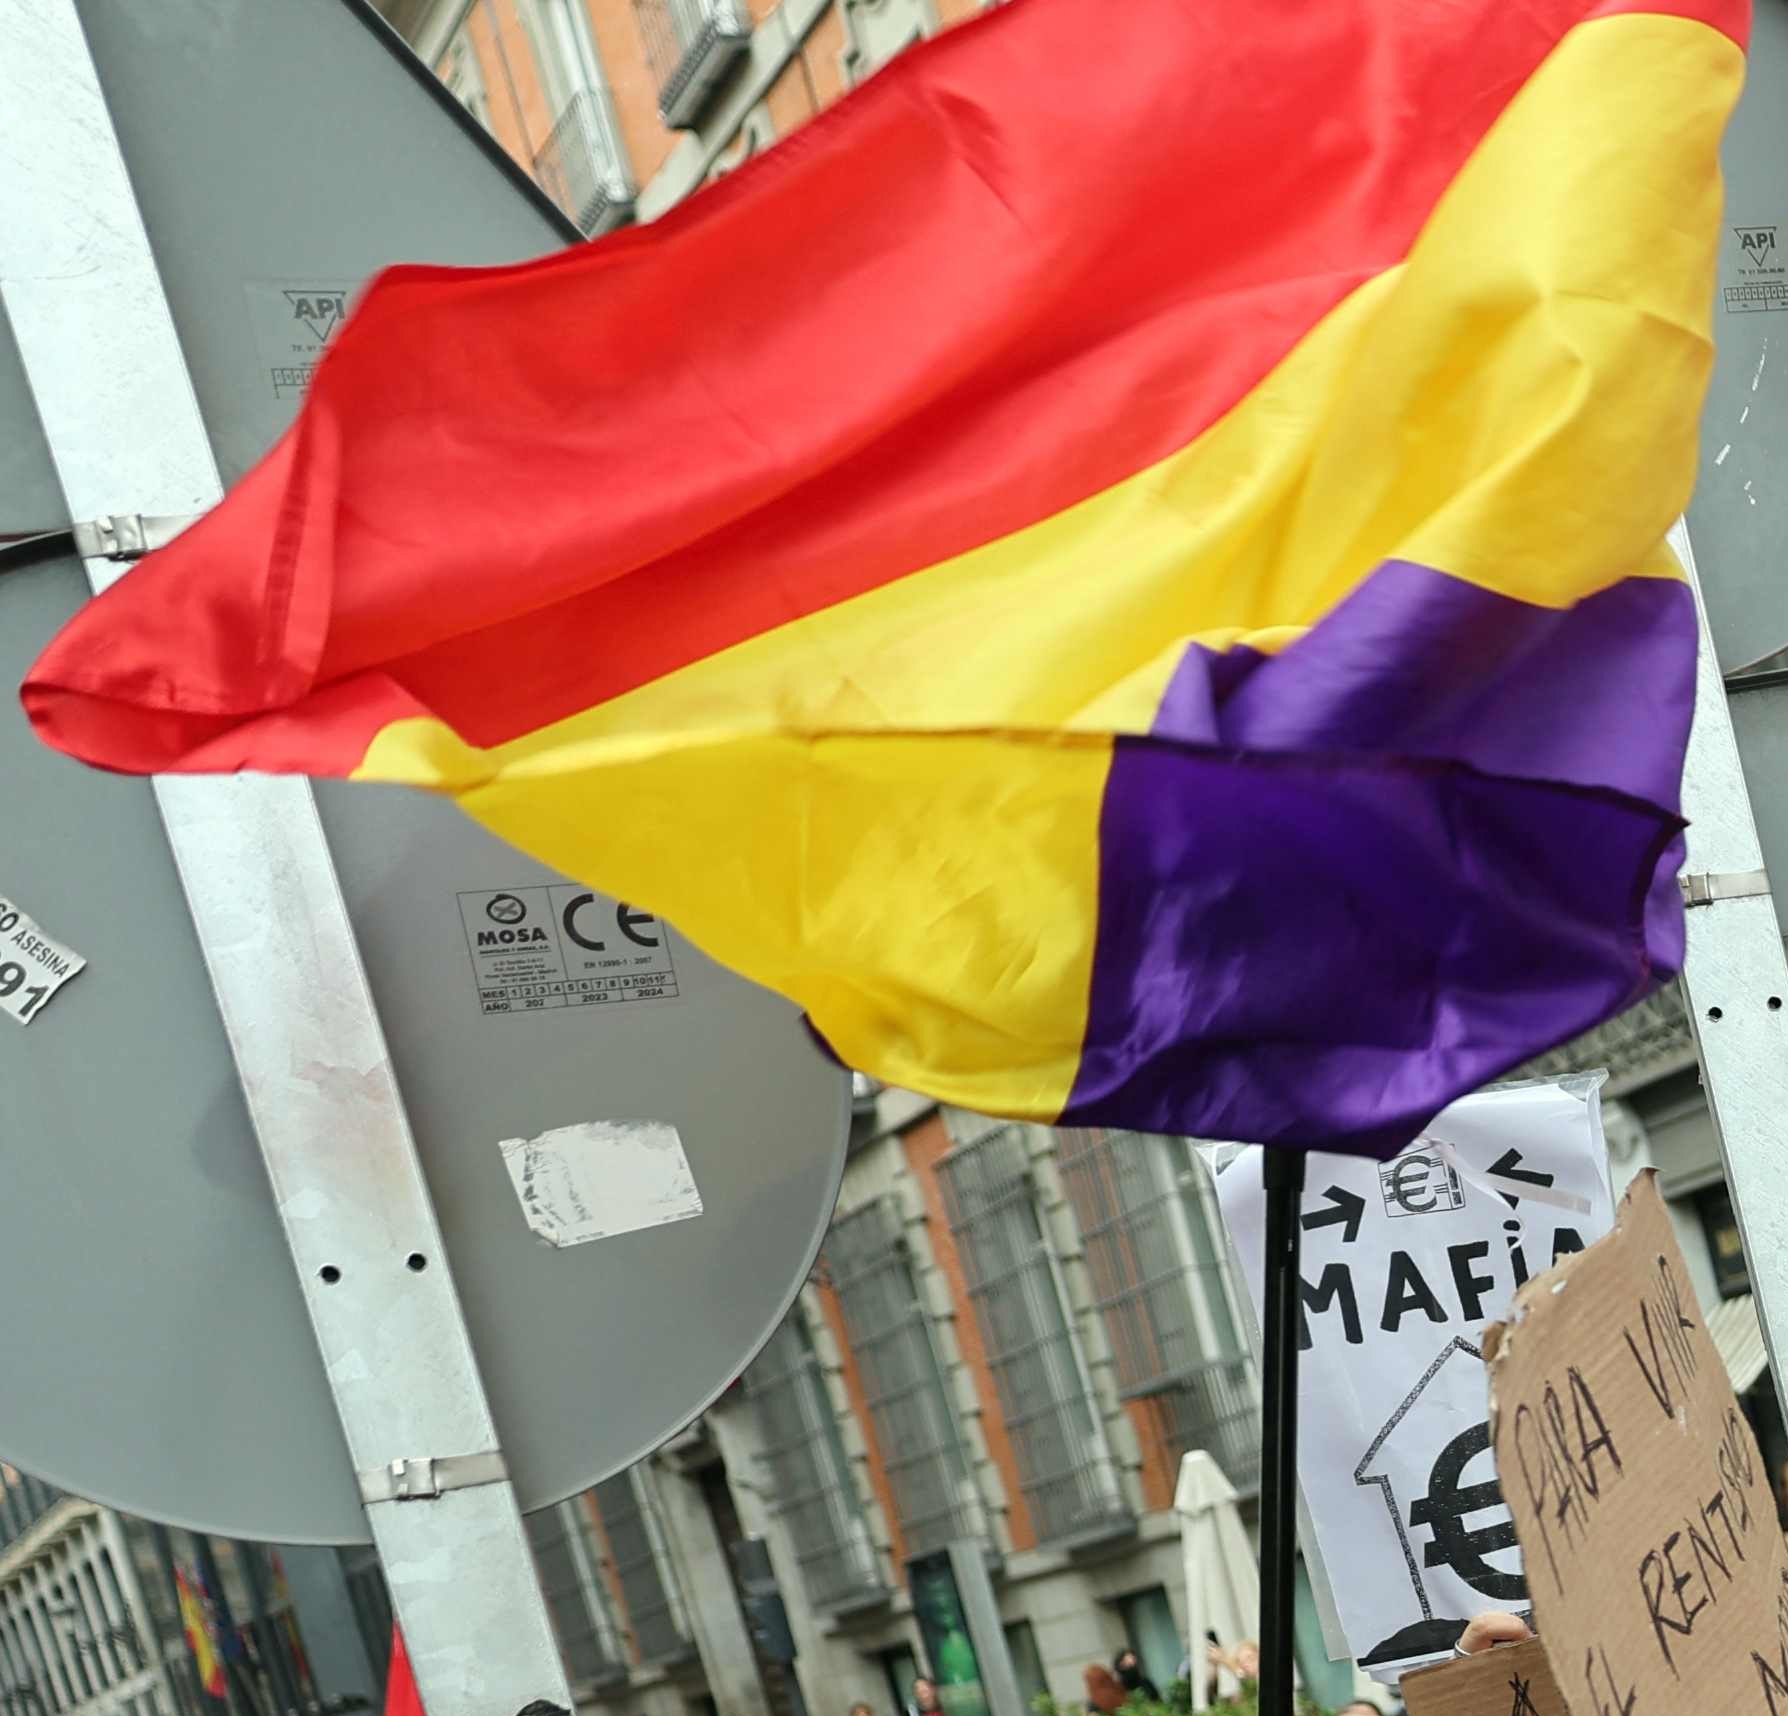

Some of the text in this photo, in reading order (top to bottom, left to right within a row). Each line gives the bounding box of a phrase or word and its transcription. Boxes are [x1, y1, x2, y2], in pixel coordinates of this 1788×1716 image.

[1741, 232, 1776, 250] API
[293, 298, 346, 320] API
[476, 927, 548, 947] MOSA
[10, 929, 70, 978] ASESINA
